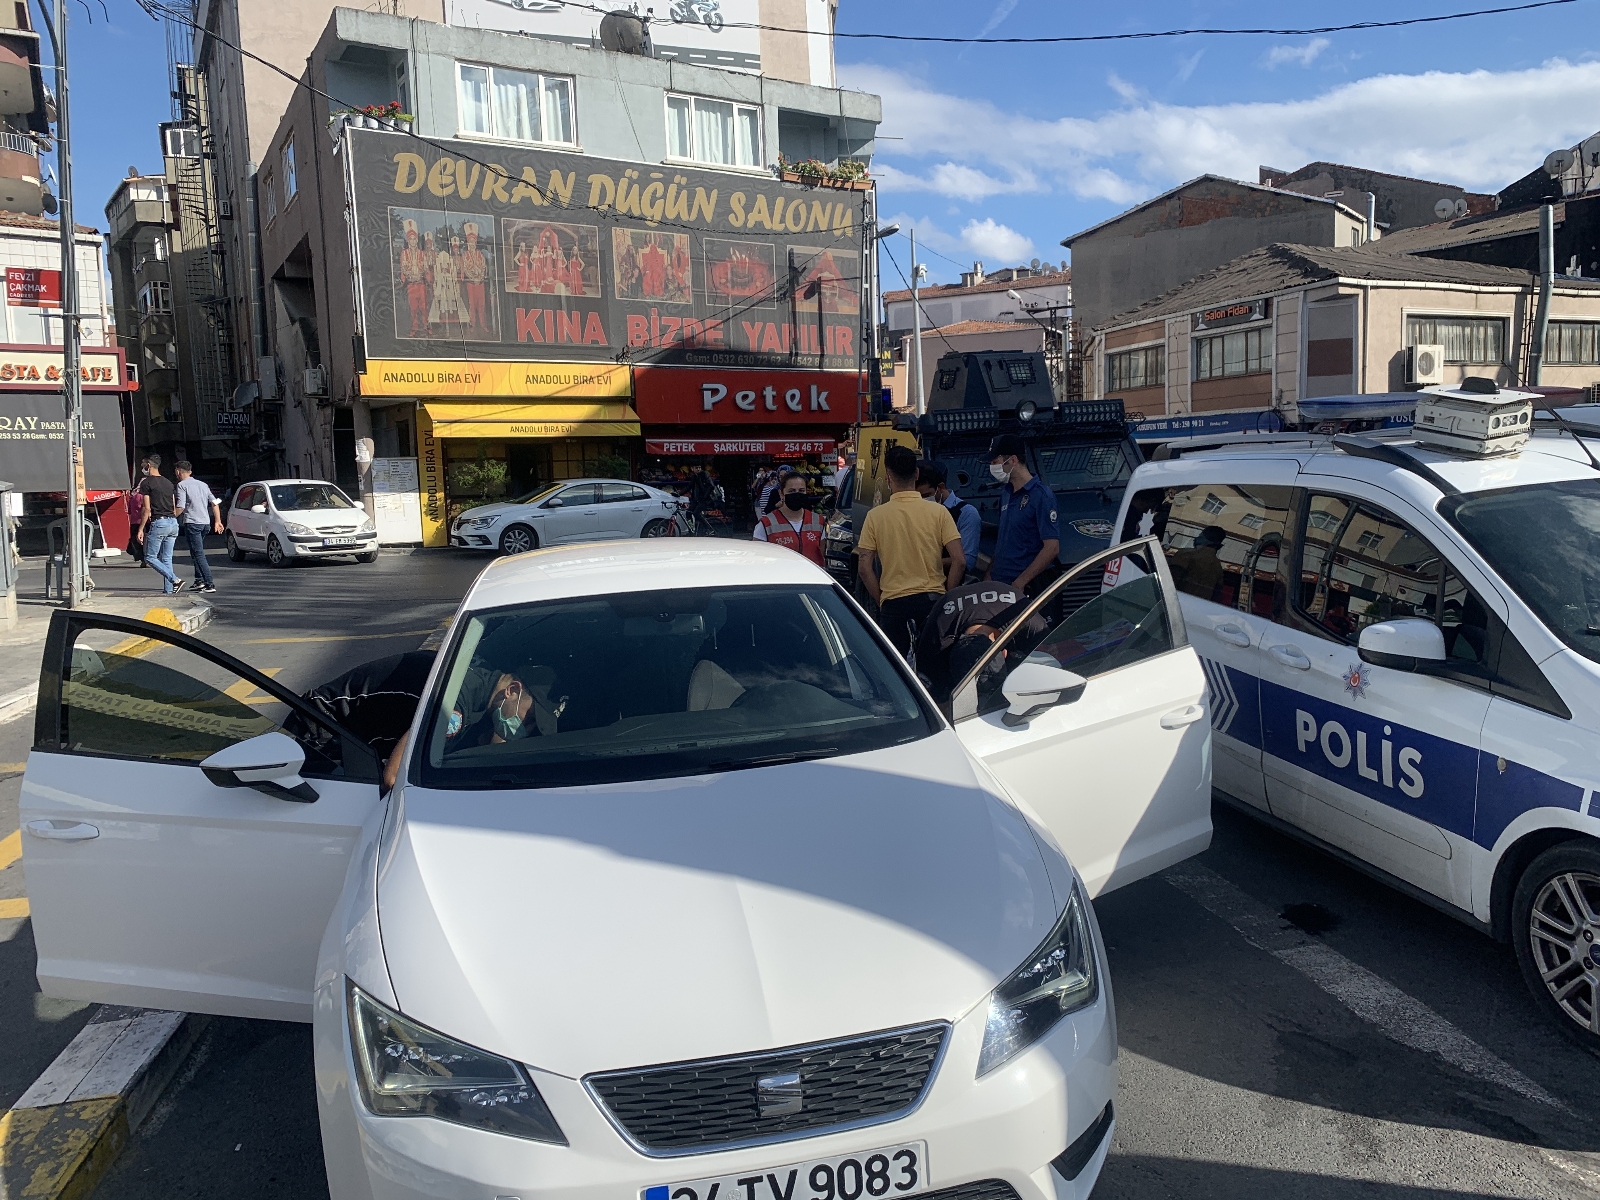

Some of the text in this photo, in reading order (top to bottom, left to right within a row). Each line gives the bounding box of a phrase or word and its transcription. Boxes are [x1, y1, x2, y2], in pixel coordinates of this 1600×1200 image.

[393, 152, 854, 237] DEVRAN DÜĞÜN SALONU
[10, 283, 47, 293] ÇAKMAK
[1205, 309, 1226, 321] Salon
[515, 308, 608, 346] KINA
[626, 308, 725, 349] BİZDE
[685, 353, 710, 364] Gsm:
[712, 354, 735, 364] 0532
[738, 356, 754, 365] 630
[81, 366, 113, 382] AFE
[383, 371, 481, 384] ANADOLU BİRA EVİ
[525, 373, 612, 386] ANADOLU BİRA EVİ
[701, 383, 831, 412] Petek
[217, 412, 250, 425] DEVRAN
[510, 425, 572, 434] ANADOLU BİRA EVİ
[663, 441, 824, 453] PETEK ŞARKÜTERİ 254 46 73
[424, 449, 436, 473] BİRA
[427, 475, 439, 523] ANADOLU
[1296, 708, 1425, 799] POLİS
[808, 1149, 919, 1200] 9083
